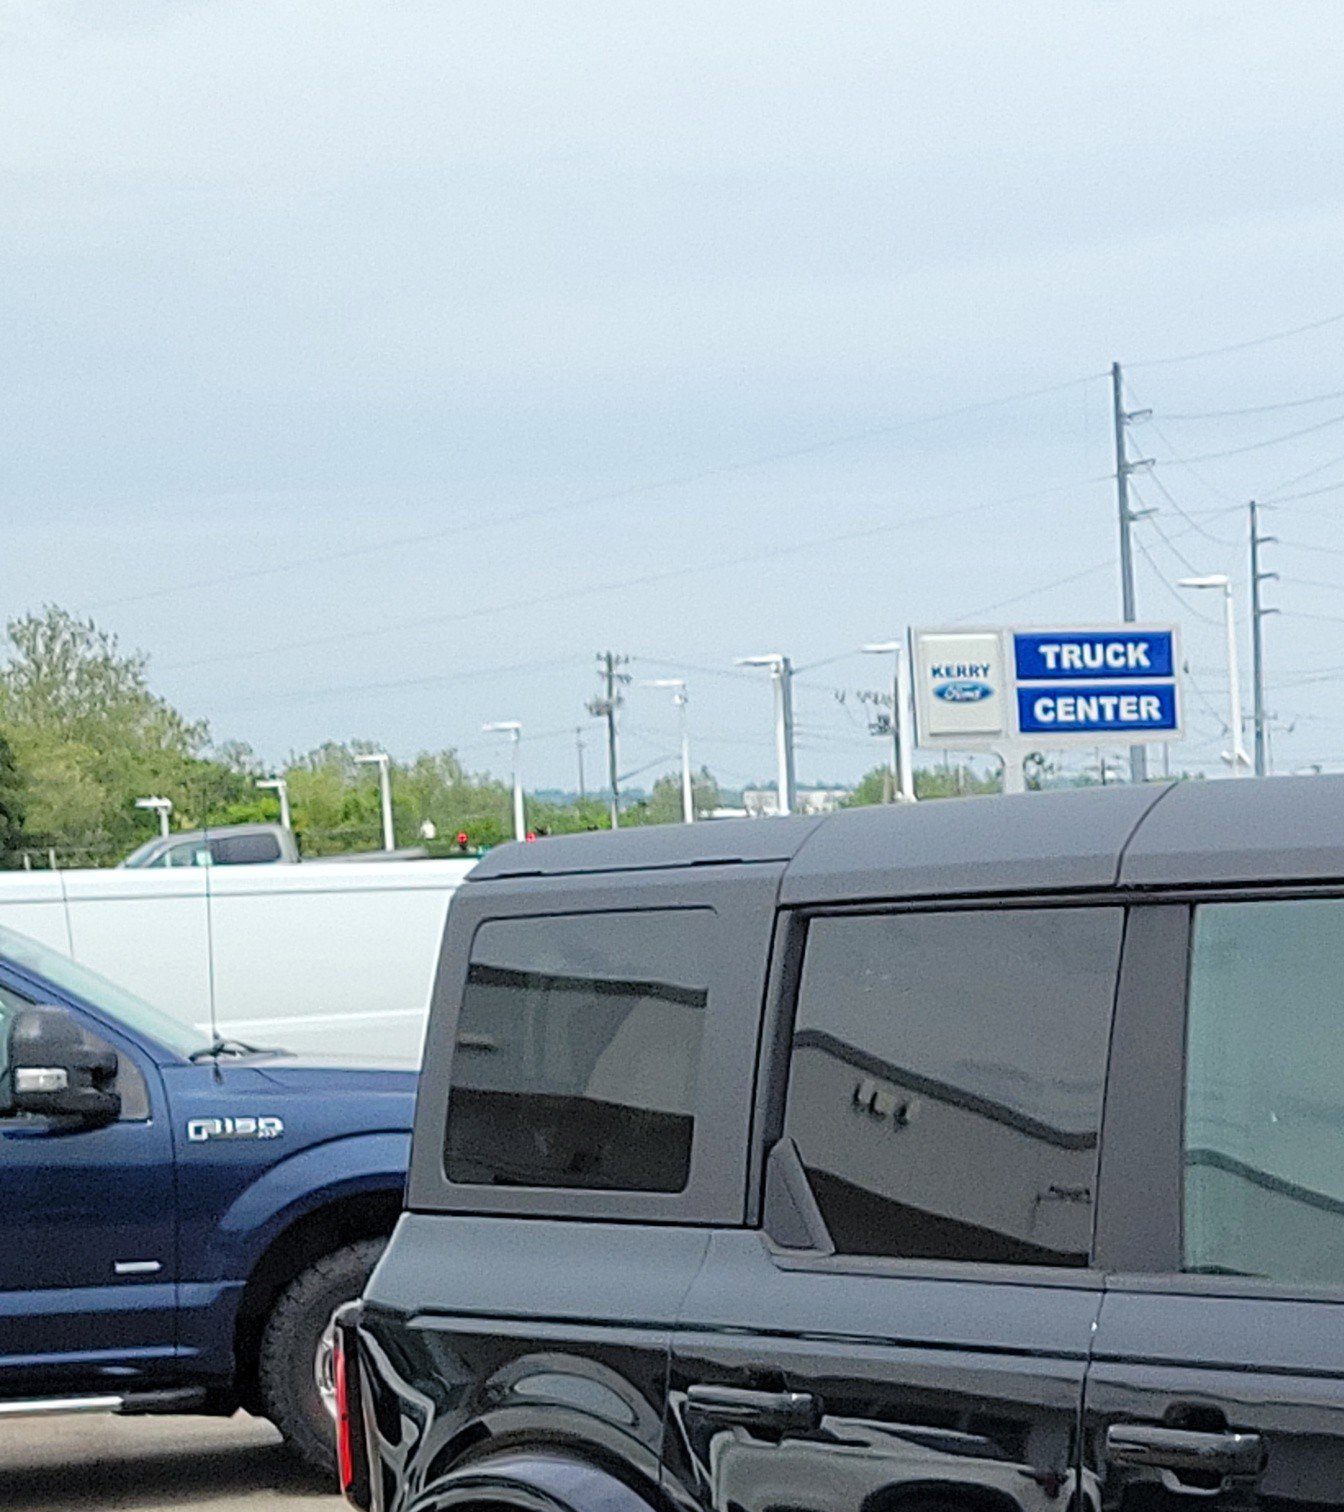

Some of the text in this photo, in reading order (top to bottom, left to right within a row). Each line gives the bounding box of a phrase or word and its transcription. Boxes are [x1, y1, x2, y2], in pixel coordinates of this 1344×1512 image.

[1038, 642, 1151, 670] TRUCK
[931, 663, 991, 678] KERRY
[1032, 695, 1162, 723] CENTER
